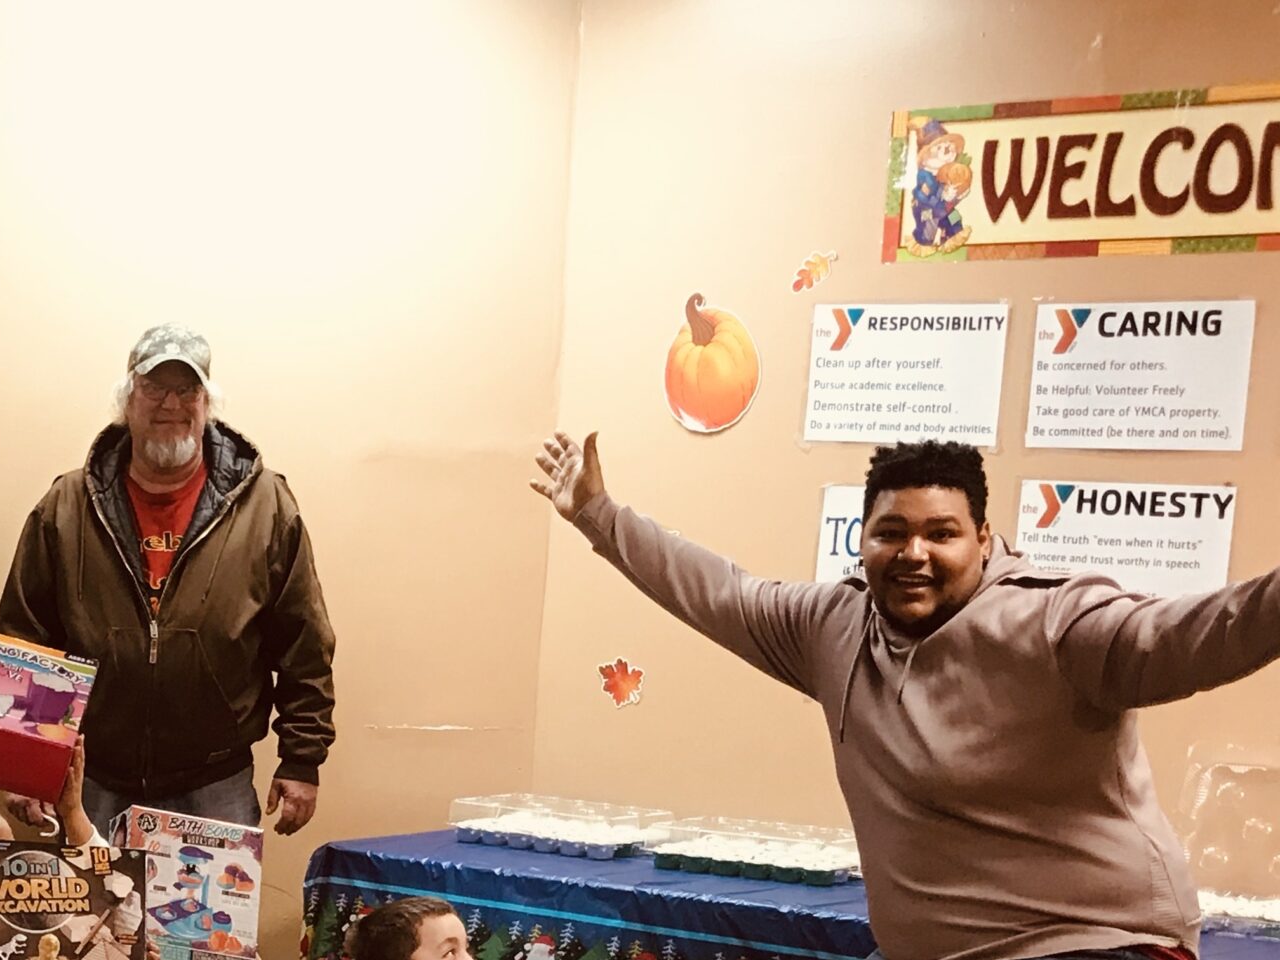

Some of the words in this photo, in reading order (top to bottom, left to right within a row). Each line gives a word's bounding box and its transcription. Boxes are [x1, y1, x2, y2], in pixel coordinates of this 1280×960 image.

[868, 316, 1005, 331] RESPONSIBILITY
[1098, 309, 1223, 338] CARING
[816, 328, 831, 338] the
[1038, 330, 1054, 340] the
[816, 357, 845, 368] Clean
[848, 360, 861, 370] up
[865, 357, 891, 368] after
[896, 358, 943, 371] yourself.
[1036, 361, 1049, 371] Be
[1052, 360, 1106, 371] concerned
[1110, 361, 1125, 371] for
[1129, 361, 1167, 371] others.
[814, 380, 845, 390] Pursue
[848, 381, 892, 391] academic
[895, 382, 946, 392] excellence.
[1036, 385, 1048, 396] Be
[1095, 385, 1149, 396] Volunteer
[1152, 385, 1186, 398] Freely
[813, 400, 883, 413] Demonstrate
[1036, 406, 1059, 417] Take
[1062, 406, 1089, 419] good
[1092, 408, 1115, 417] care
[1118, 406, 1130, 416] of
[1134, 406, 1166, 417] YMCA
[1169, 407, 1221, 420] property.
[810, 420, 823, 430] Do
[833, 421, 864, 431] variety
[866, 421, 876, 431] of
[879, 422, 901, 432] mind
[904, 422, 920, 432] and
[923, 423, 945, 434] body
[948, 424, 993, 434] activities.
[1032, 426, 1045, 437] Be
[1048, 427, 1103, 437] committed
[1106, 425, 1123, 438] (be
[1126, 427, 1155, 438] there
[1158, 428, 1179, 438] and
[1182, 430, 1196, 438] on
[1200, 427, 1232, 440] time).
[1022, 504, 1038, 515] the
[1076, 489, 1234, 520] HONESTY
[1022, 532, 1039, 543] Tell
[1042, 534, 1059, 544] the
[1062, 535, 1089, 545] truth
[1125, 537, 1153, 548] when
[1156, 539, 1164, 548] it
[1033, 552, 1067, 562] sincere
[1069, 553, 1087, 564] and
[1090, 554, 1114, 565] trust
[1117, 556, 1150, 568] worthy
[1153, 558, 1162, 567] in
[1165, 559, 1201, 570] speech
[21, 651, 88, 683] FACTORY
[168, 817, 202, 834] BATH
[205, 824, 243, 840] BOMB
[91, 847, 109, 863] 10
[1, 858, 28, 877] 10
[30, 862, 47, 874] IN
[47, 857, 59, 876] 1
